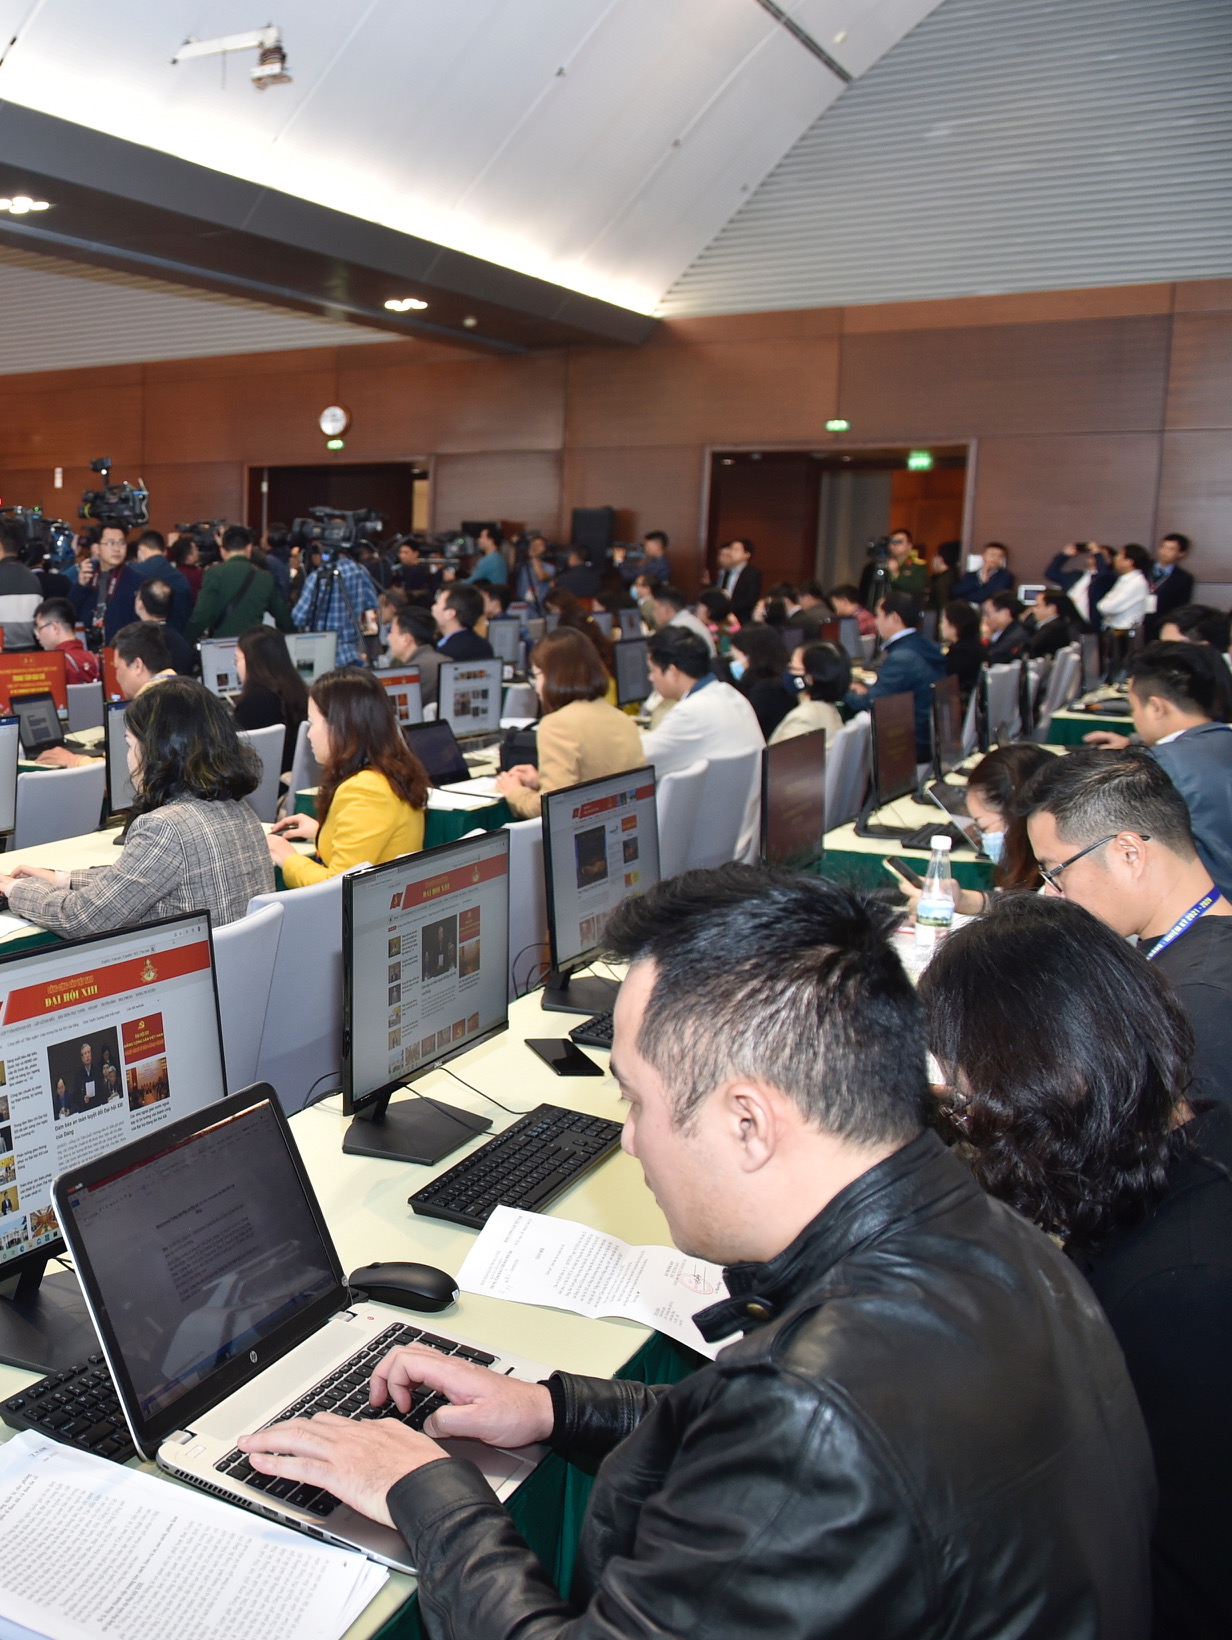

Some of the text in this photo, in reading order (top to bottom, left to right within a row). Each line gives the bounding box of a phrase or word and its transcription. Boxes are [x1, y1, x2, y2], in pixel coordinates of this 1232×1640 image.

[1185, 908, 1200, 921] 2021
[44, 985, 98, 1008] ĐẠI HỘI XIII
